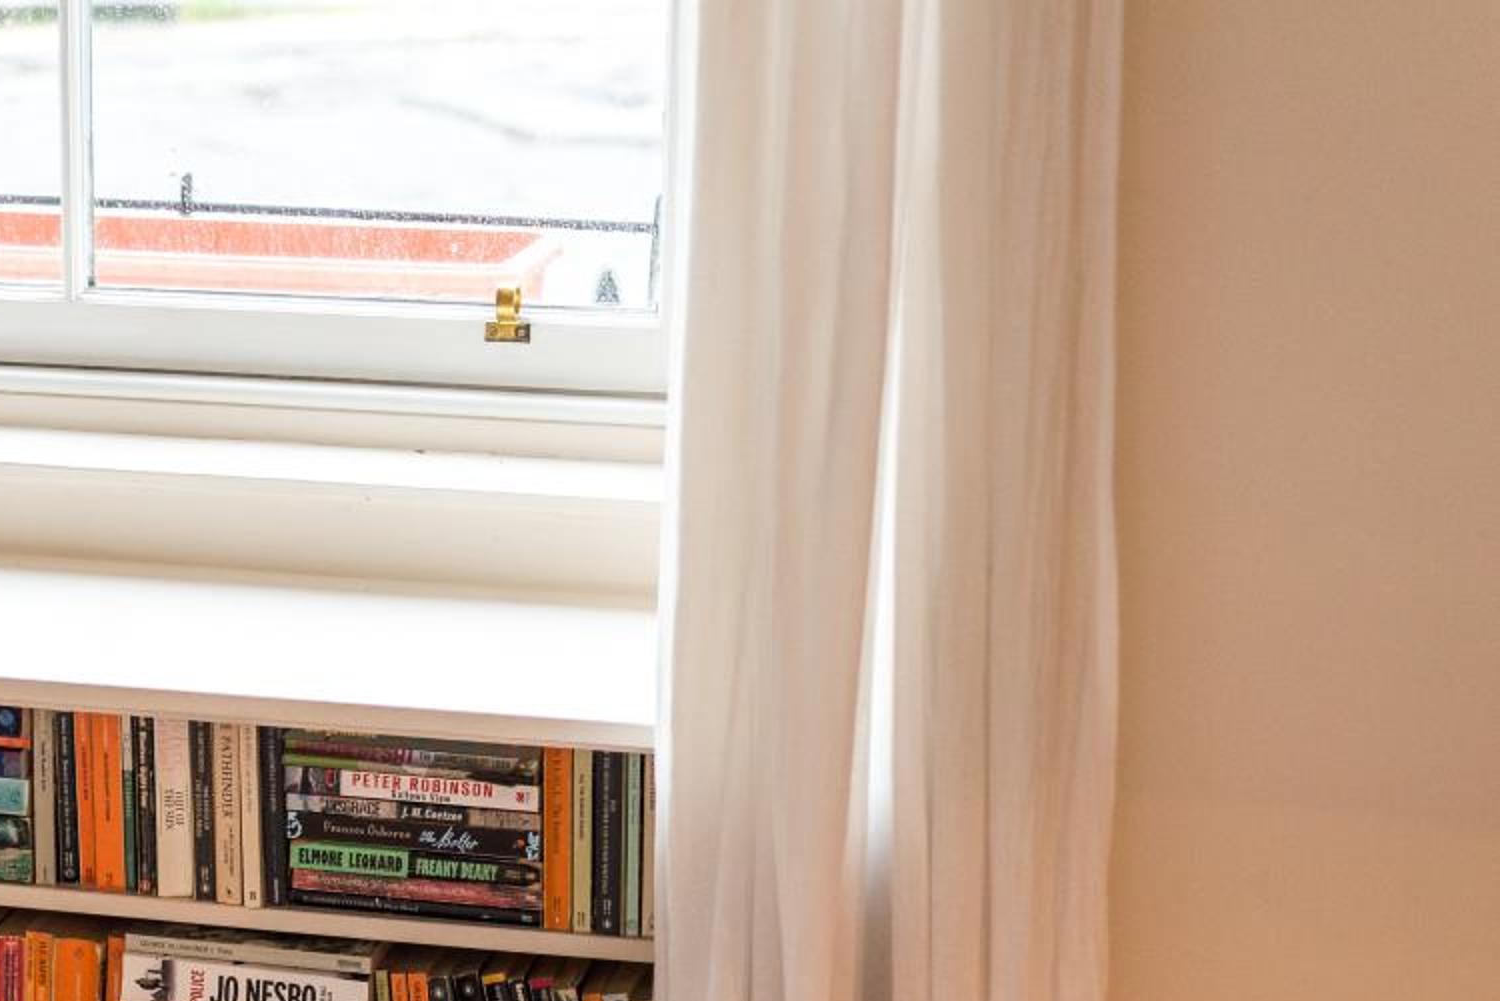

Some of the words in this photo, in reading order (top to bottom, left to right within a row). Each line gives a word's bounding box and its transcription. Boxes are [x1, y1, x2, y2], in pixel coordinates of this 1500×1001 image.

[352, 771, 401, 791] PETER
[409, 777, 494, 798] ROBINSON
[299, 848, 343, 866] ELMORE
[350, 851, 403, 872] LEONARD
[416, 858, 458, 878] FREAKY
